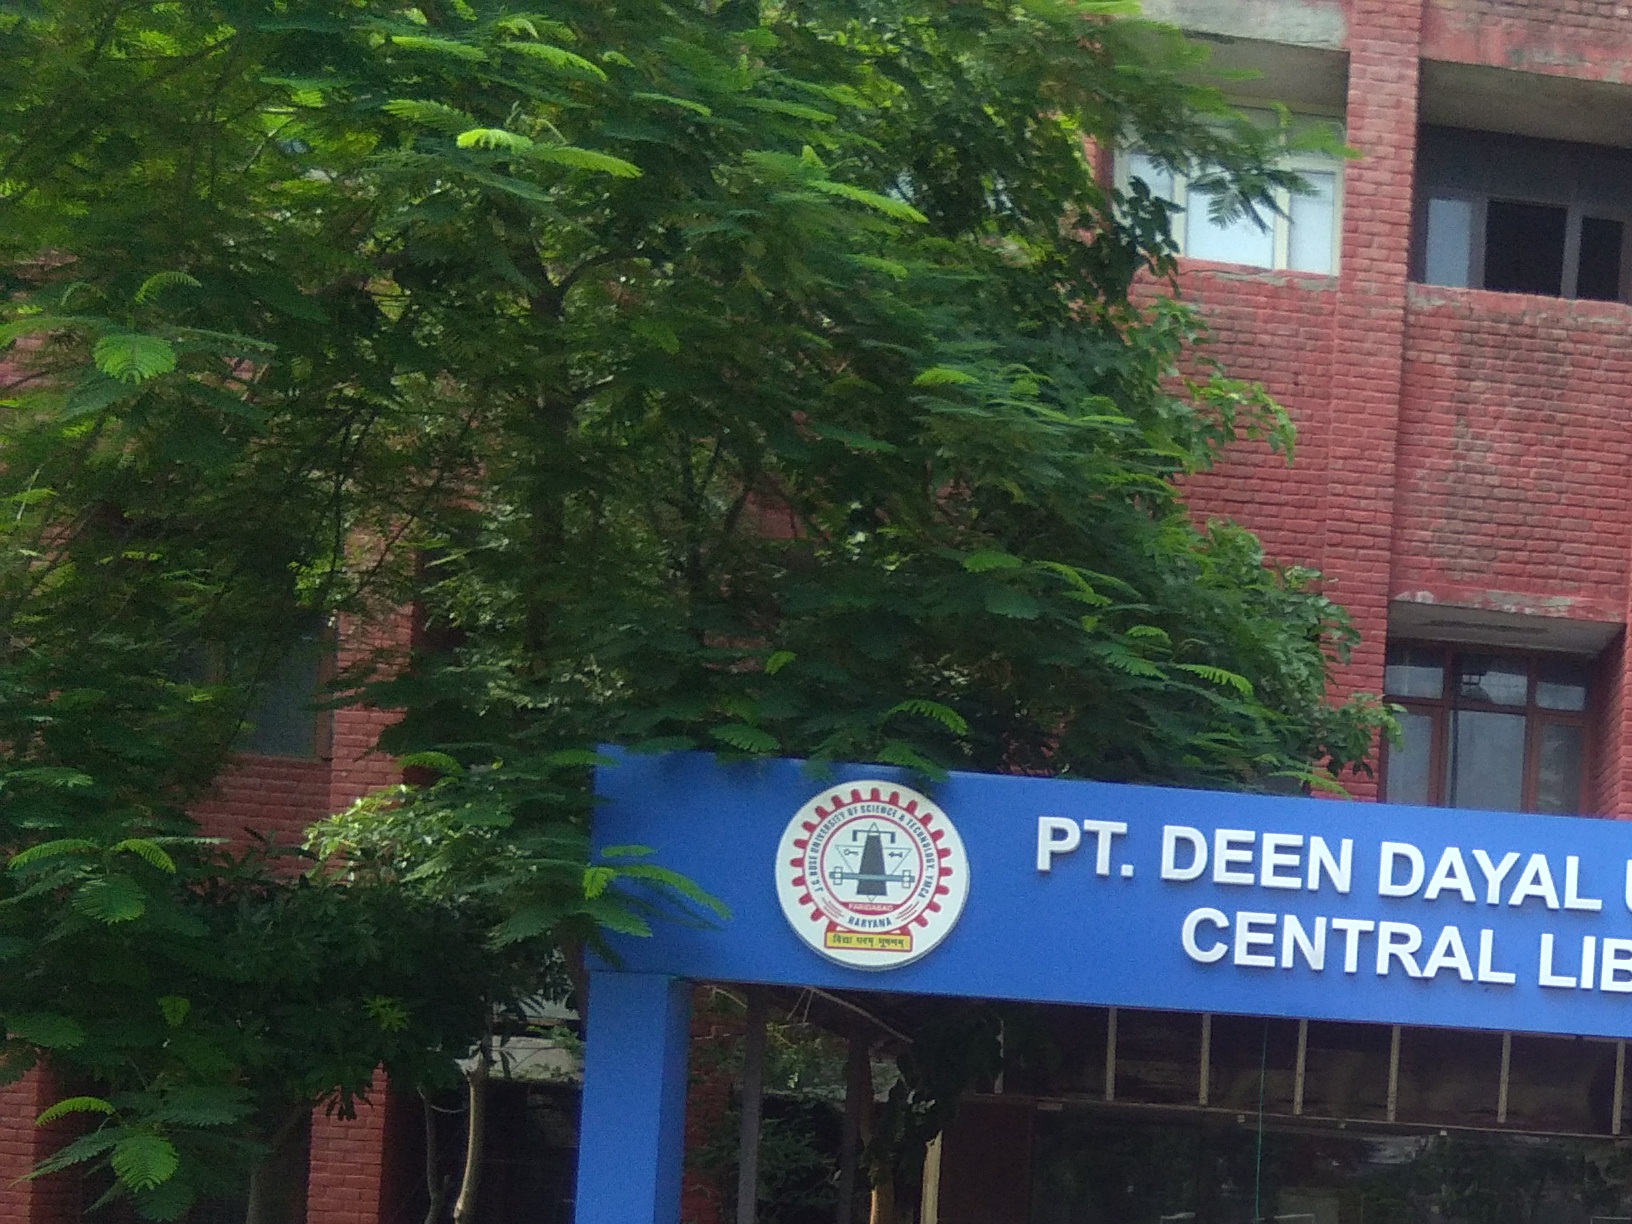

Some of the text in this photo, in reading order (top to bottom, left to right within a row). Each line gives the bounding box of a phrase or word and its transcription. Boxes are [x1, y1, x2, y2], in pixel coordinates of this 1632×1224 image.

[810, 811, 846, 853] UNIVERSITY
[847, 806, 858, 816] OF
[860, 804, 898, 818] SCIENCE
[918, 875, 934, 898] YMCA
[1037, 816, 1134, 877] PT.
[1160, 824, 1353, 893] DEEN
[1377, 841, 1602, 910] DAYAL
[848, 903, 893, 911] FARIDABAD
[848, 916, 892, 928] HARYANA
[1181, 907, 1516, 985] CENTRAL
